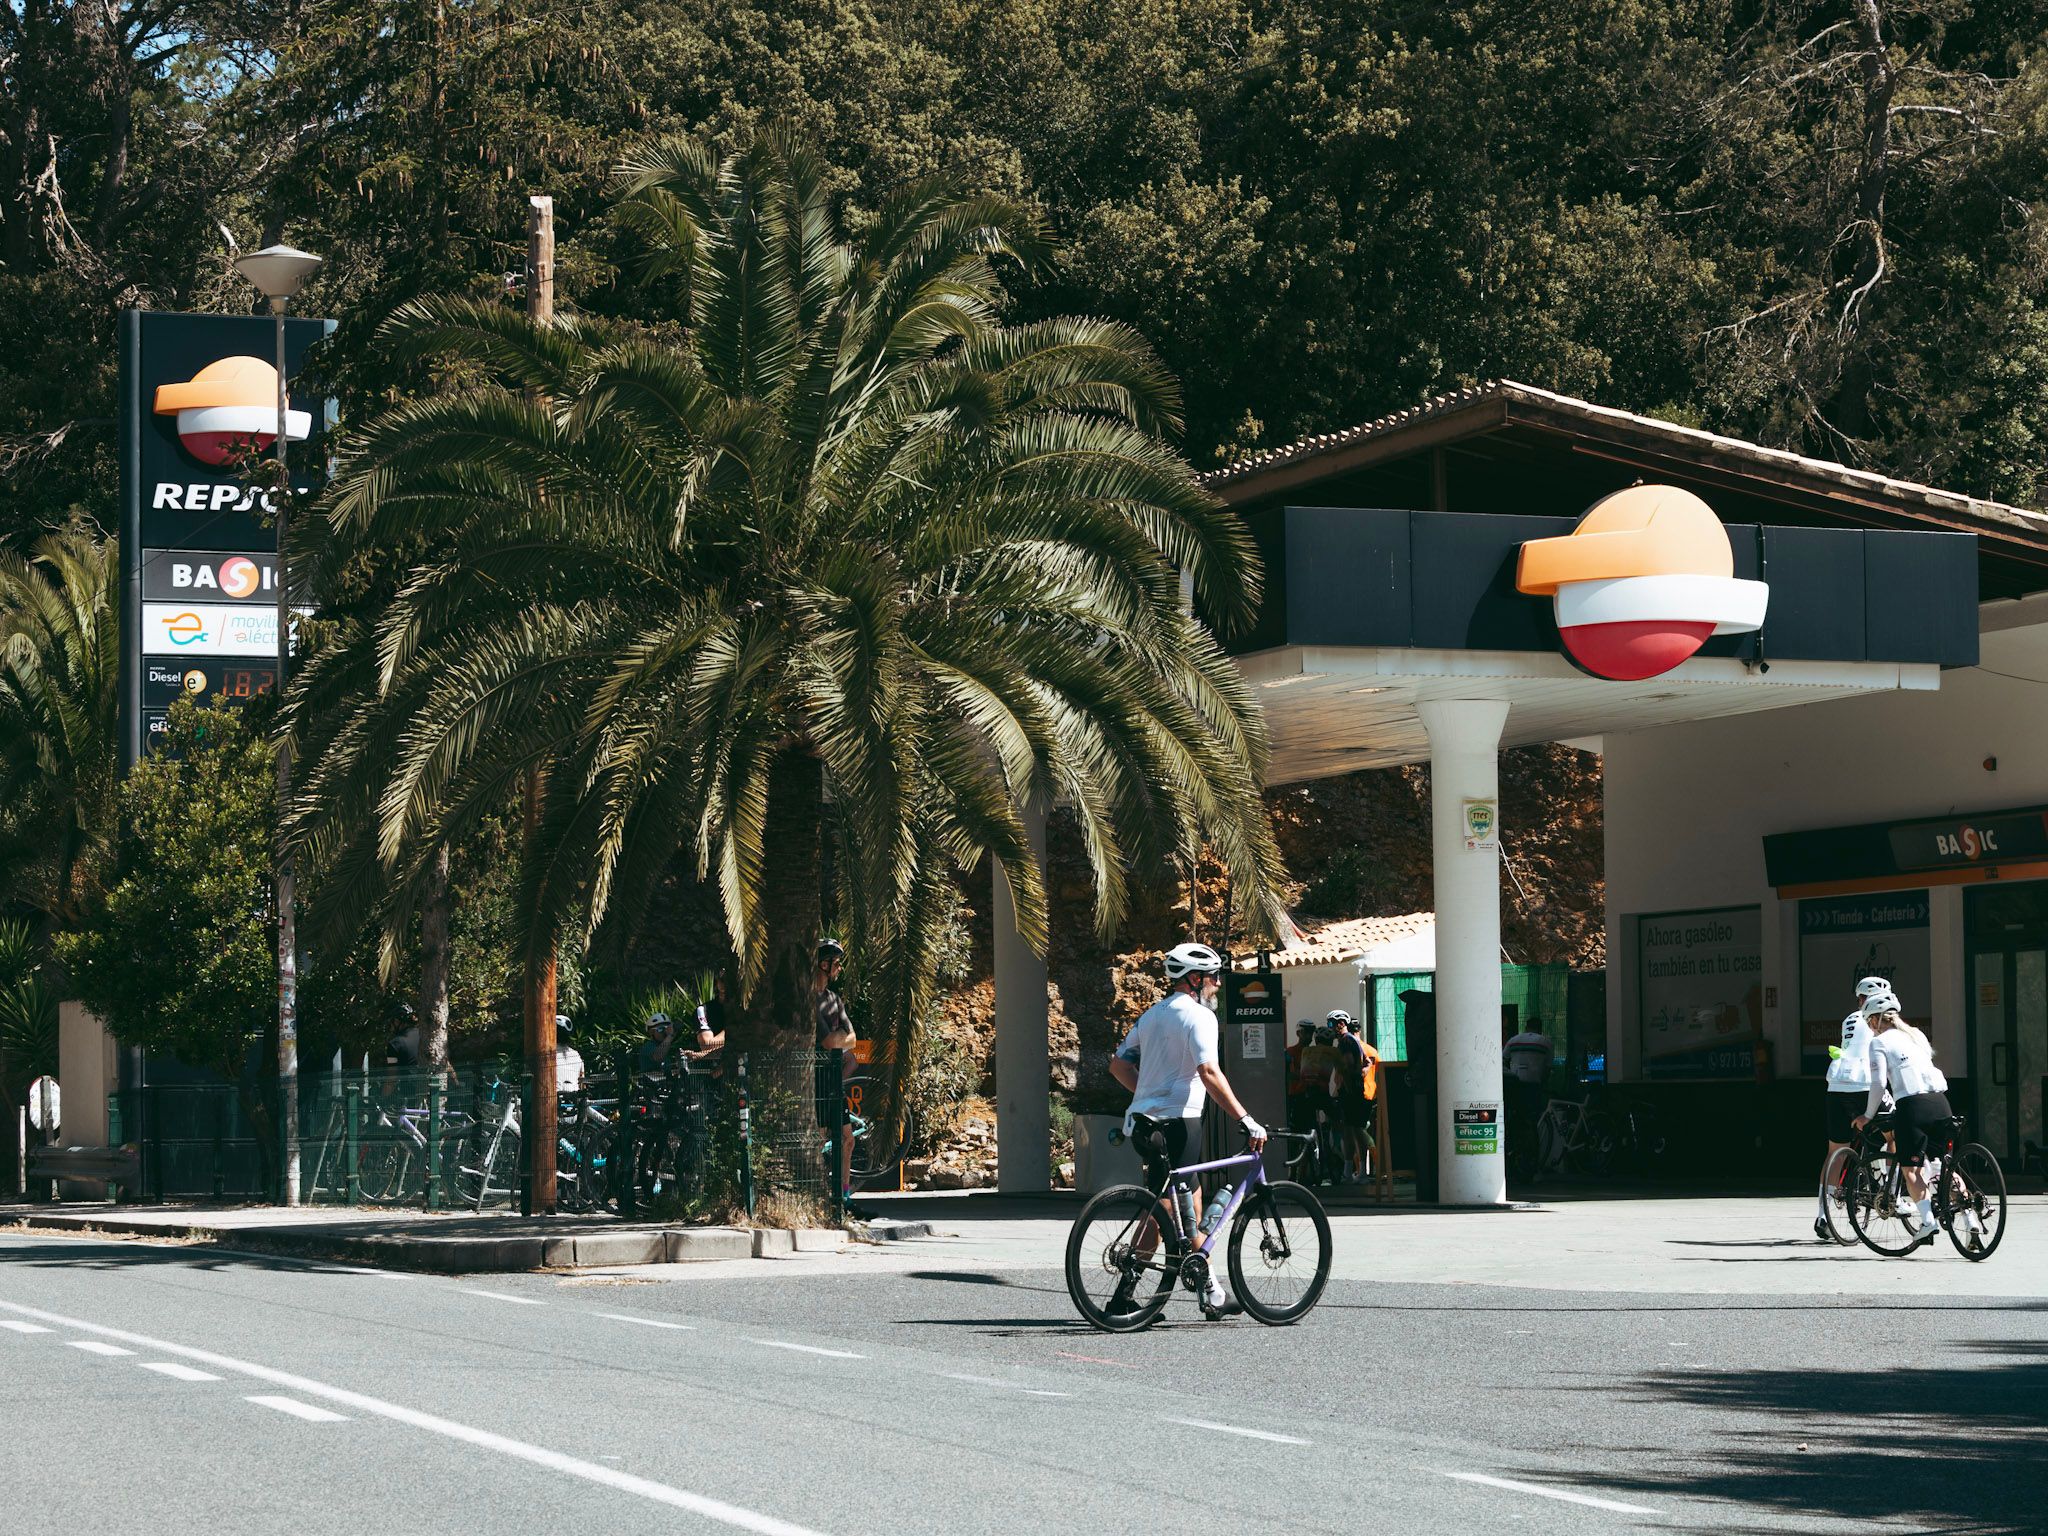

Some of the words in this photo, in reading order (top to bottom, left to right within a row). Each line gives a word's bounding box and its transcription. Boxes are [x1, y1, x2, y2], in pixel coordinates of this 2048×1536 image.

[152, 482, 309, 514] REPSO
[231, 615, 279, 628] movili
[234, 629, 279, 644] eléct
[149, 671, 182, 682] Diesel
[149, 720, 172, 732] efi
[1936, 827, 1999, 857] BASIC
[1832, 910, 1864, 925] Tienda
[1871, 904, 1916, 923] Cafetería
[1646, 925, 1682, 947] Ahora
[1685, 922, 1733, 948] gasóleo
[1220, 954, 1230, 969] 2
[1259, 953, 1268, 968] 1
[1648, 954, 1696, 978] también
[1699, 960, 1715, 975] en
[1718, 954, 1730, 973] tu
[1734, 956, 1762, 973] casa
[1235, 1007, 1275, 1016] REPSOL
[1720, 1052, 1737, 1068] 971
[1483, 1127, 1494, 1136] 95
[1483, 1142, 1494, 1151] 98
